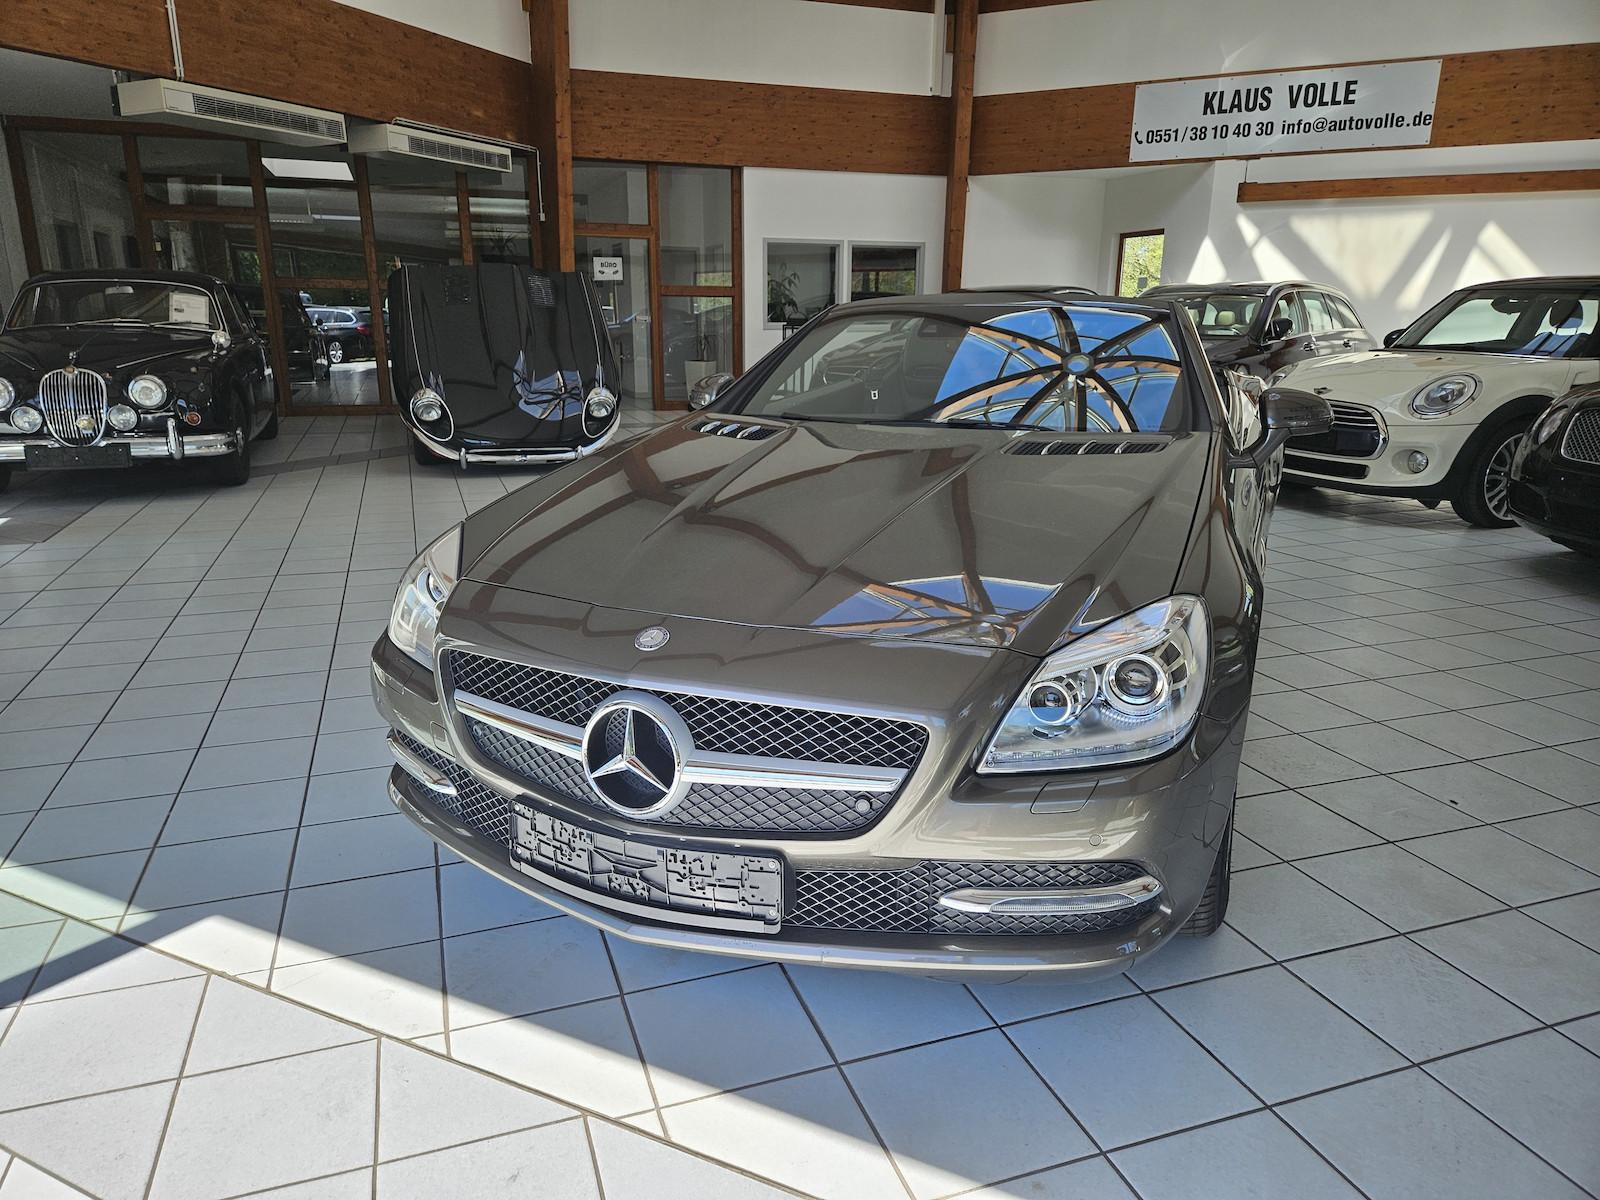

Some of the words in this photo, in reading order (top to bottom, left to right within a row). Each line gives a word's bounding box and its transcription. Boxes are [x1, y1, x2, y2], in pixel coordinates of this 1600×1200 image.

[1202, 86, 1273, 115] KLAUS
[1288, 80, 1358, 109] VOLLE
[1146, 126, 1208, 144] 0551/38
[1211, 124, 1229, 139] 10
[1232, 122, 1251, 138] 40
[1255, 121, 1274, 136] 30
[1281, 111, 1433, 135] info@autovolle.de
